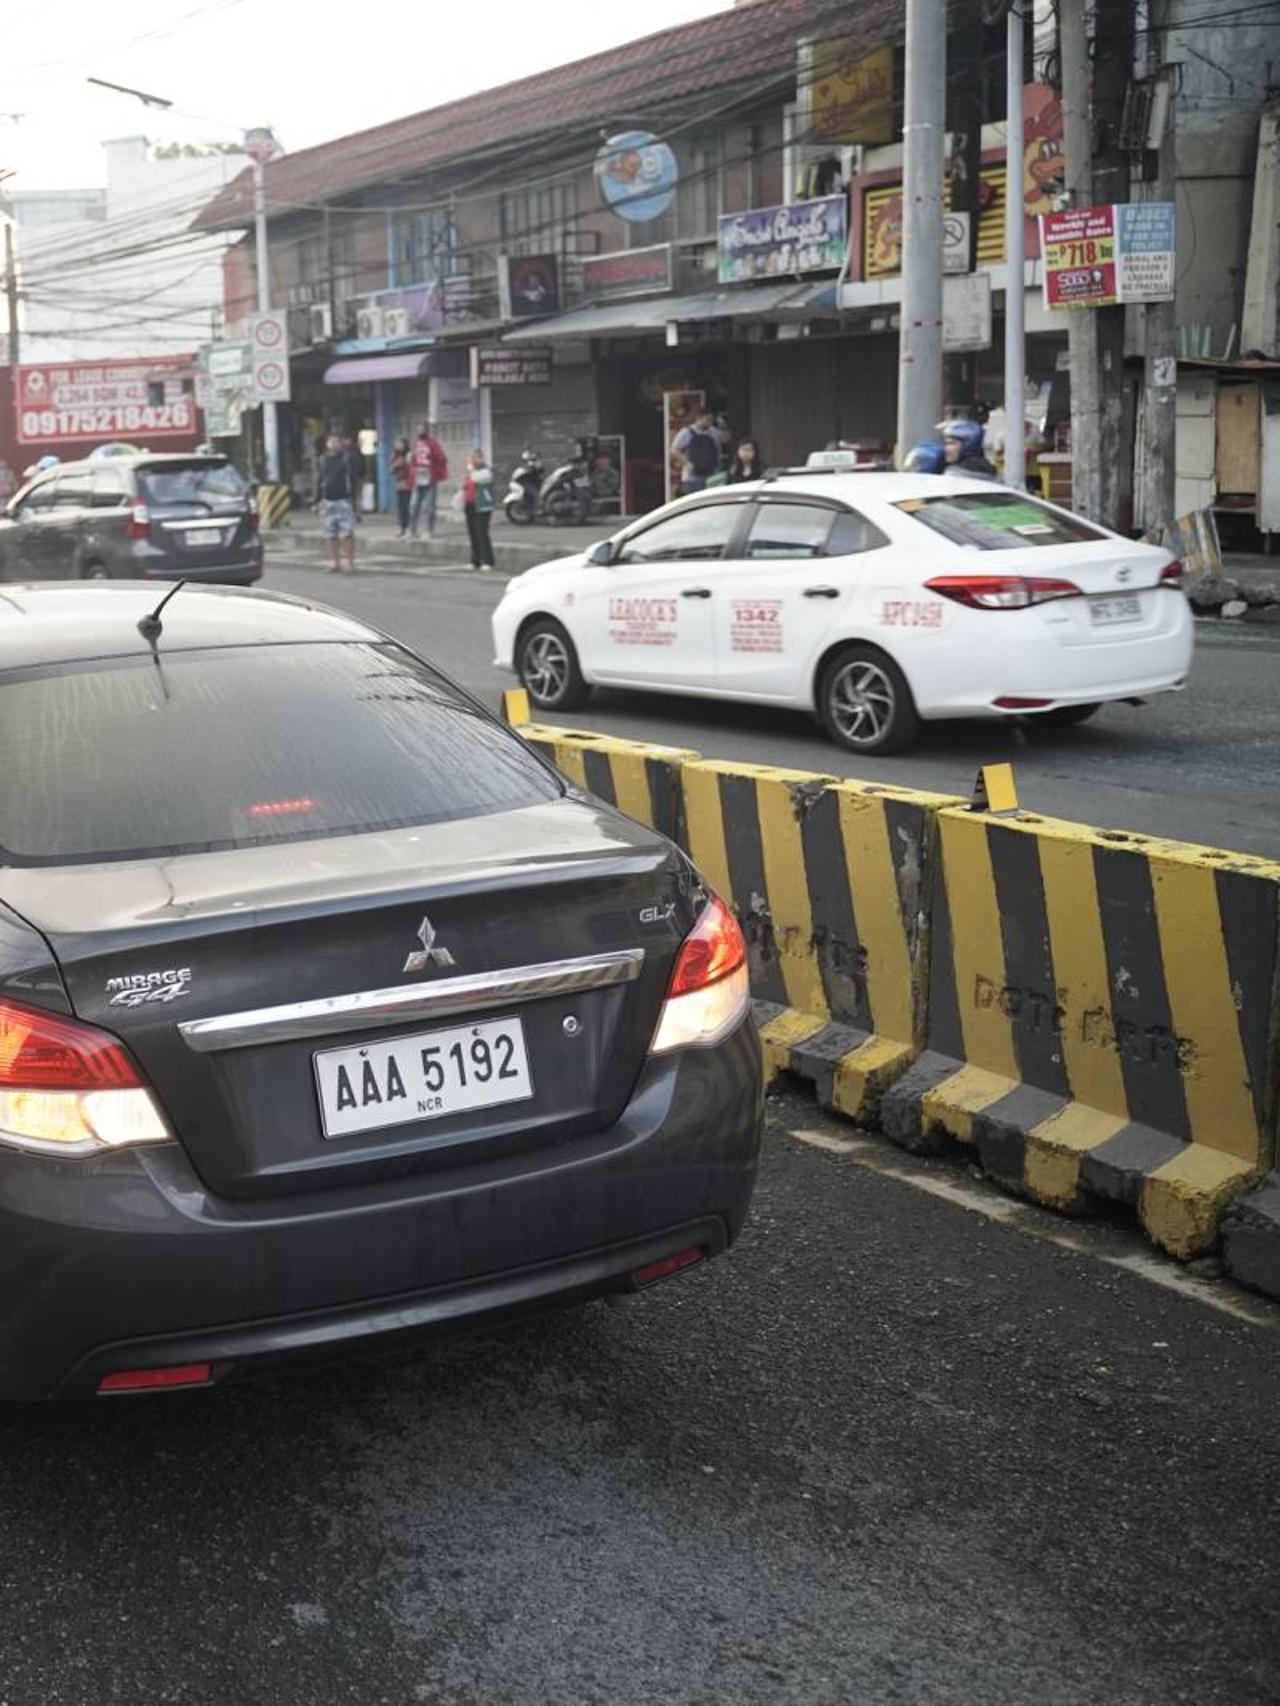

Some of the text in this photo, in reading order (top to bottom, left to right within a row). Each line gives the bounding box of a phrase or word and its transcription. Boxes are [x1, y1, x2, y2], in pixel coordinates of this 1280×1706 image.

[23, 405, 189, 436] 09175218426
[735, 609, 778, 622] 1342
[639, 903, 677, 922] GLX
[105, 968, 192, 991] MIRAGE
[110, 981, 192, 1007] G4
[337, 1034, 518, 1111] AAA 5192
[417, 1096, 443, 1113] NCR
